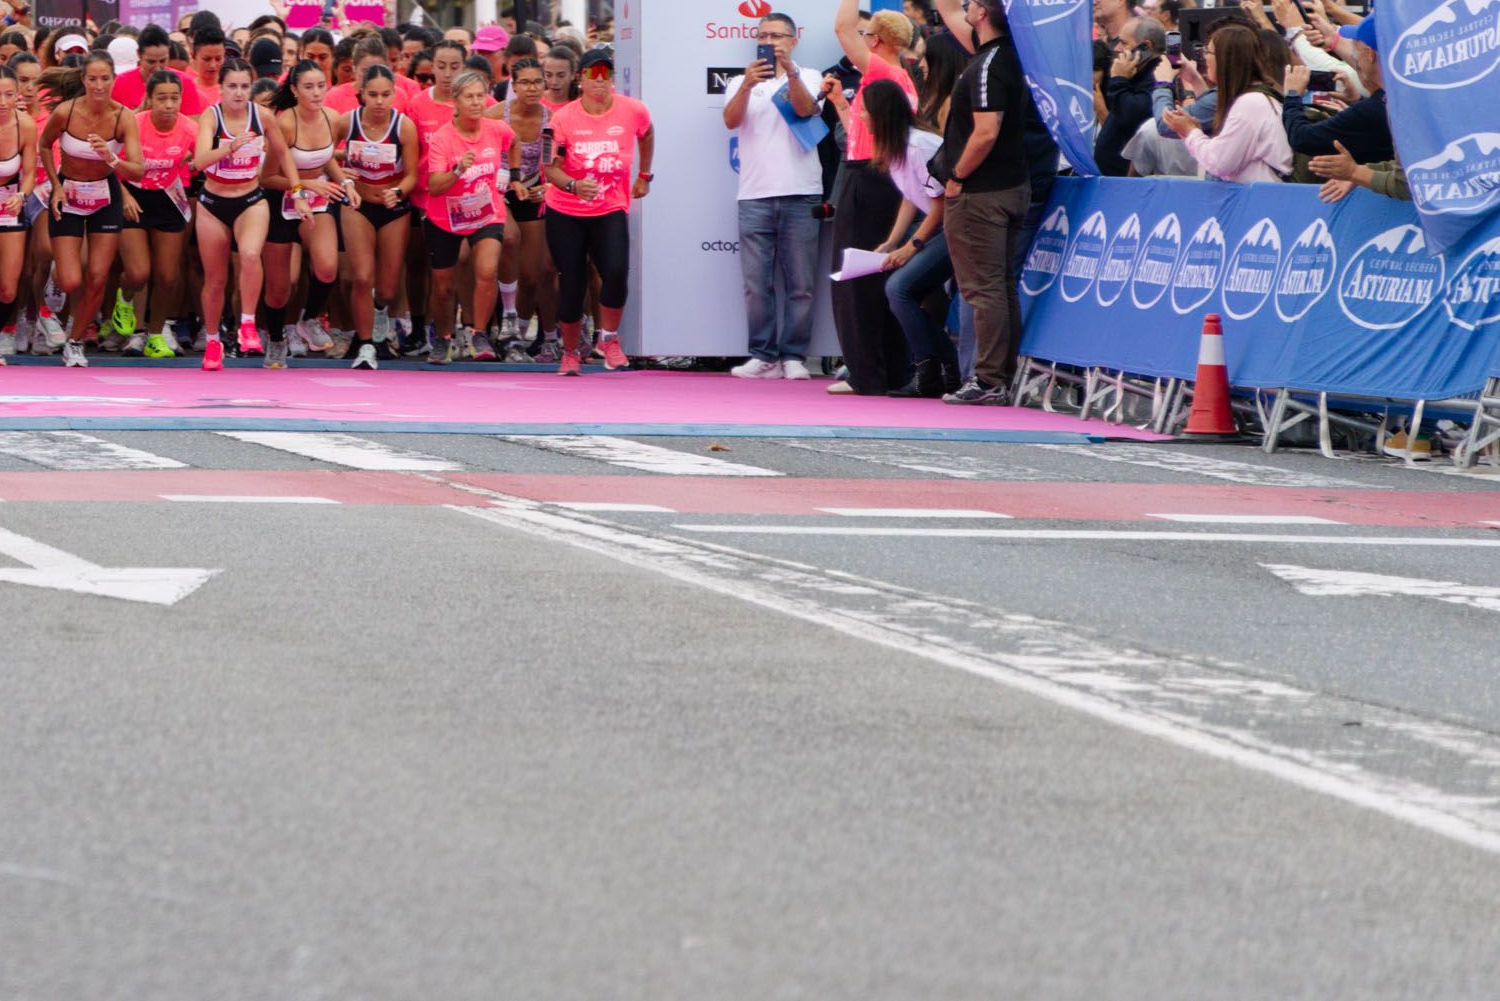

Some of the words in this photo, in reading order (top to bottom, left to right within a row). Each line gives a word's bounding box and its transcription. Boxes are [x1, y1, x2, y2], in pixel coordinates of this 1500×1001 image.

[574, 140, 620, 154] CARRERA
[701, 240, 739, 254] octop
[1343, 258, 1435, 305] ASTURIANA
